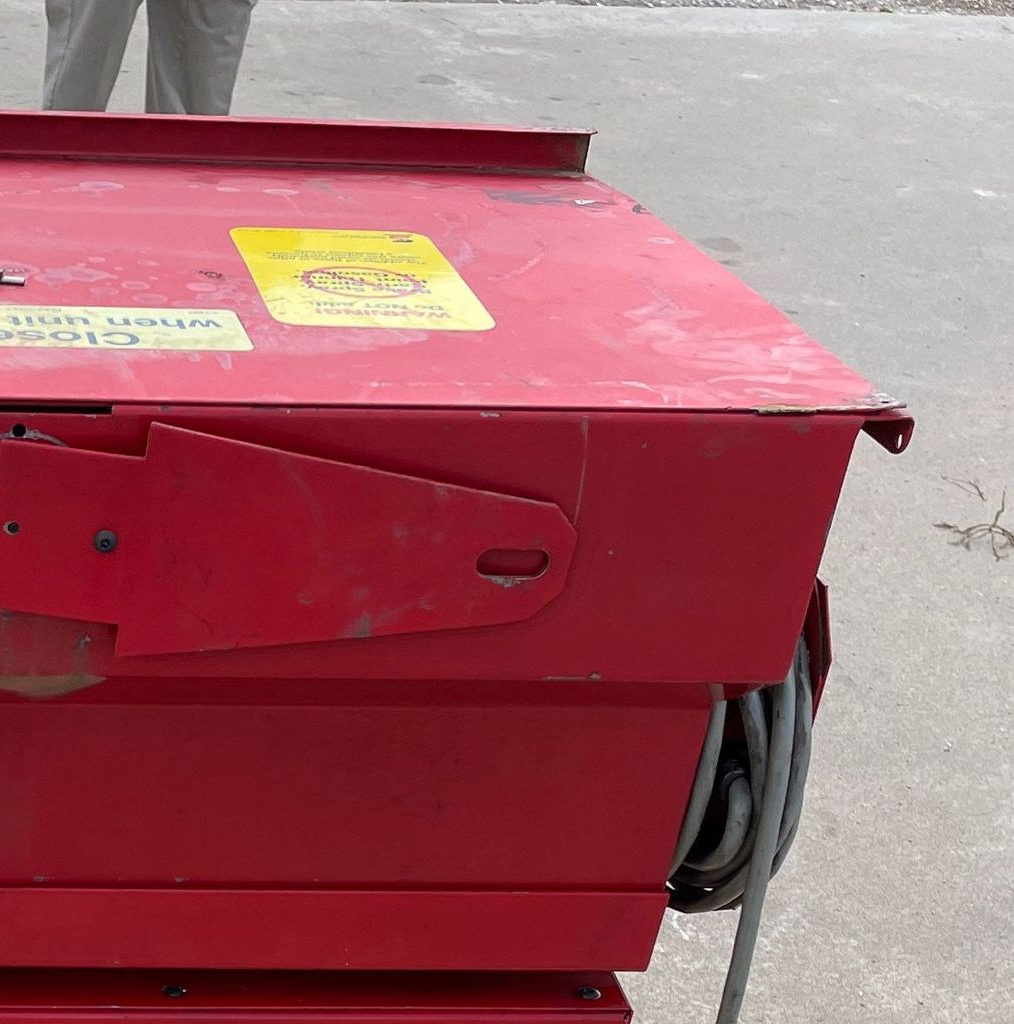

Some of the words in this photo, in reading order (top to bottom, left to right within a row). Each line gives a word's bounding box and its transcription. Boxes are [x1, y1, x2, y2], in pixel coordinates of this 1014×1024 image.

[364, 302, 409, 310] NOT
[414, 303, 445, 311] Do
[315, 308, 452, 318] WARNING!
[10, 314, 91, 327] unit
[106, 318, 222, 330] when
